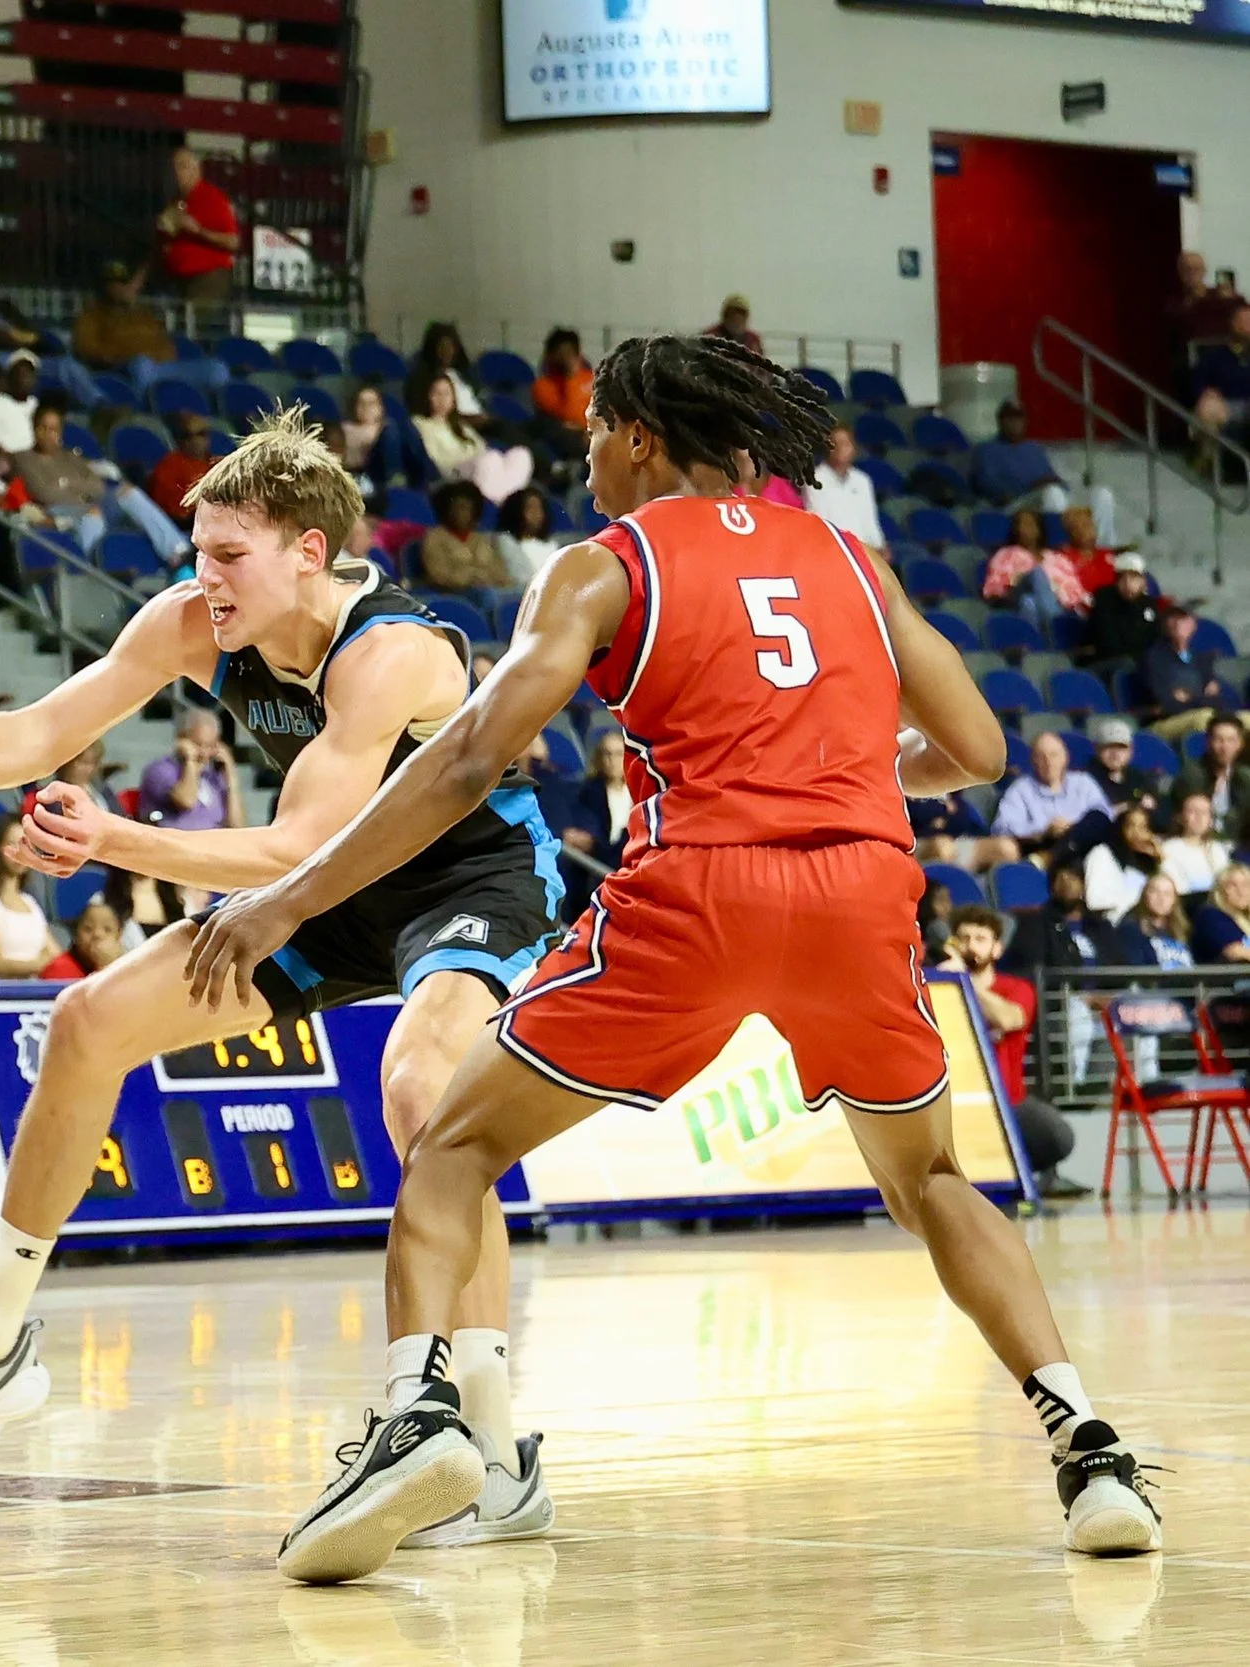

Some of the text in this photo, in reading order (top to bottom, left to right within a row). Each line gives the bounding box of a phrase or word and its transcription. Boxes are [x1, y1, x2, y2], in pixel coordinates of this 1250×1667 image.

[736, 576, 820, 690] 5
[220, 1103, 295, 1133] PERIOD
[269, 1142, 291, 1189] 1
[1081, 1456, 1115, 1469] CURRY
